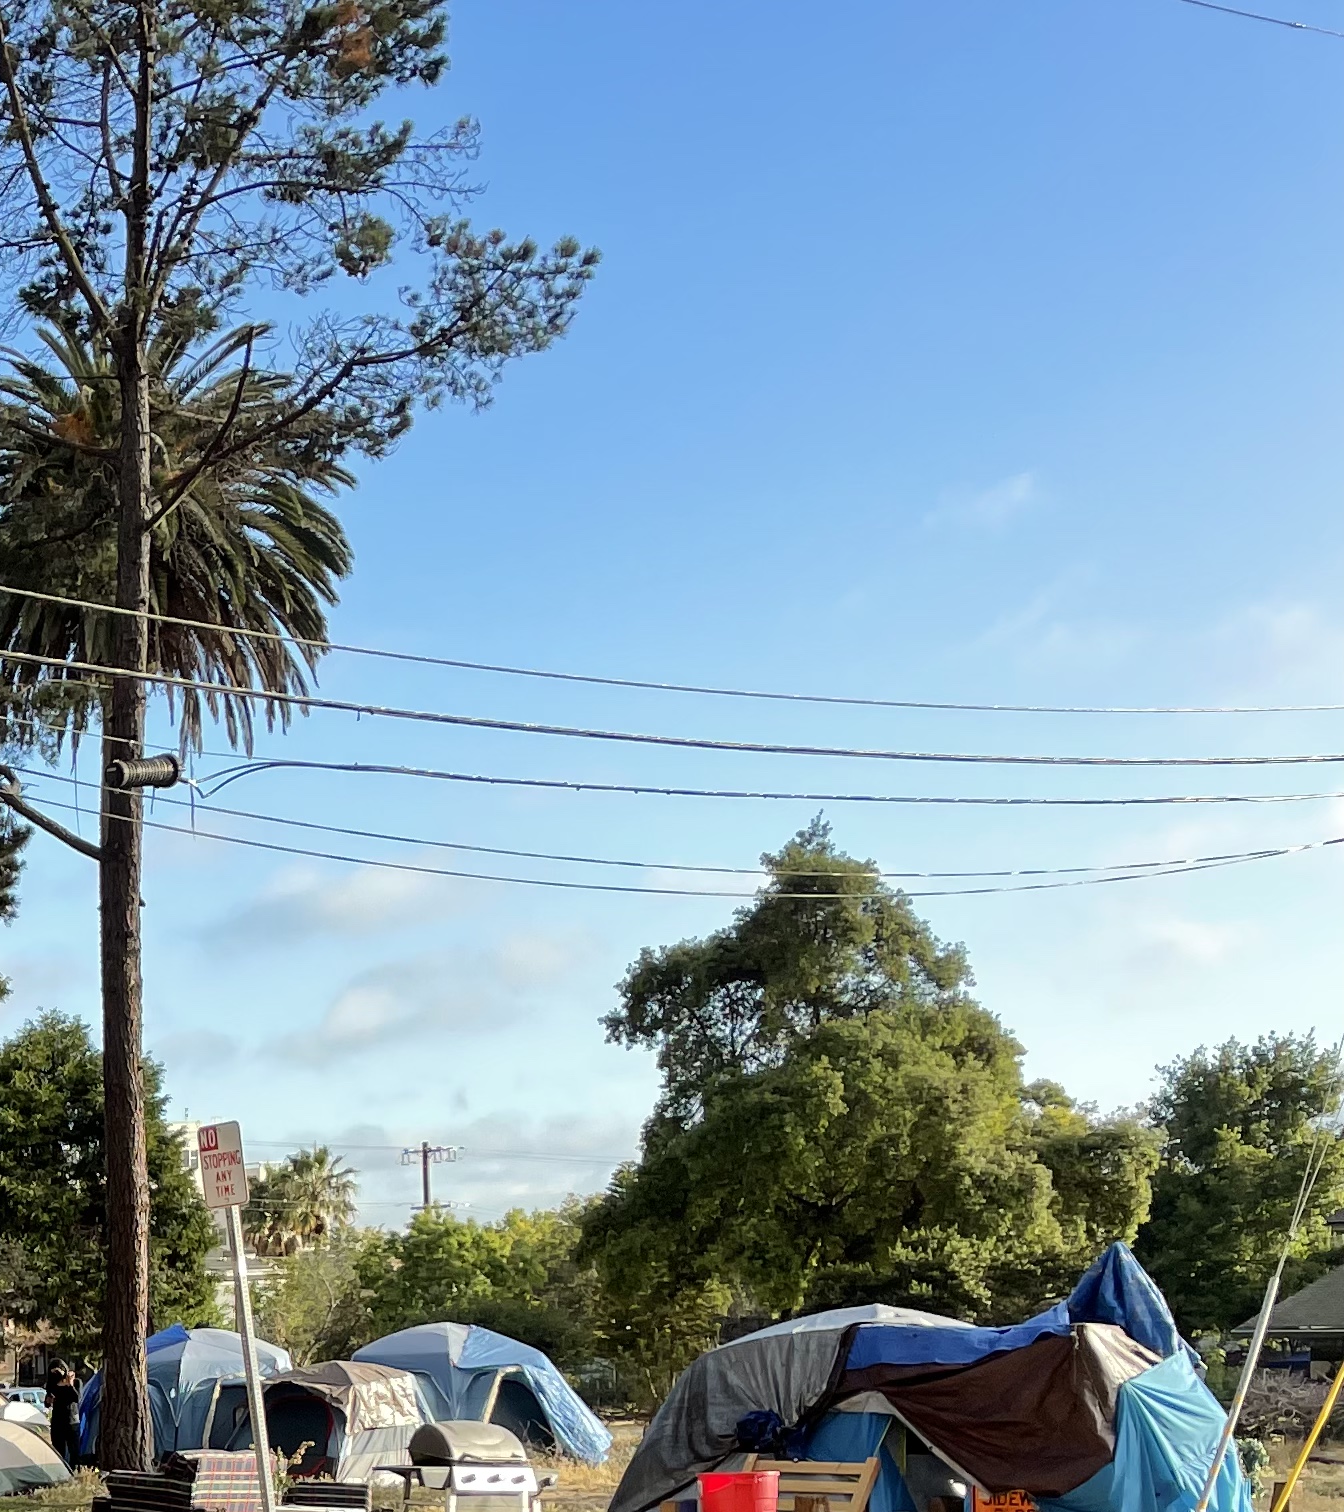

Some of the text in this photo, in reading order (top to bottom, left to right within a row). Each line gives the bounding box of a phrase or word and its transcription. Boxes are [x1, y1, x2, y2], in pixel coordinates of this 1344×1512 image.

[200, 1128, 217, 1150] NO
[203, 1149, 242, 1171] STOPPING
[215, 1169, 233, 1184] ANY
[216, 1183, 236, 1198] TIME
